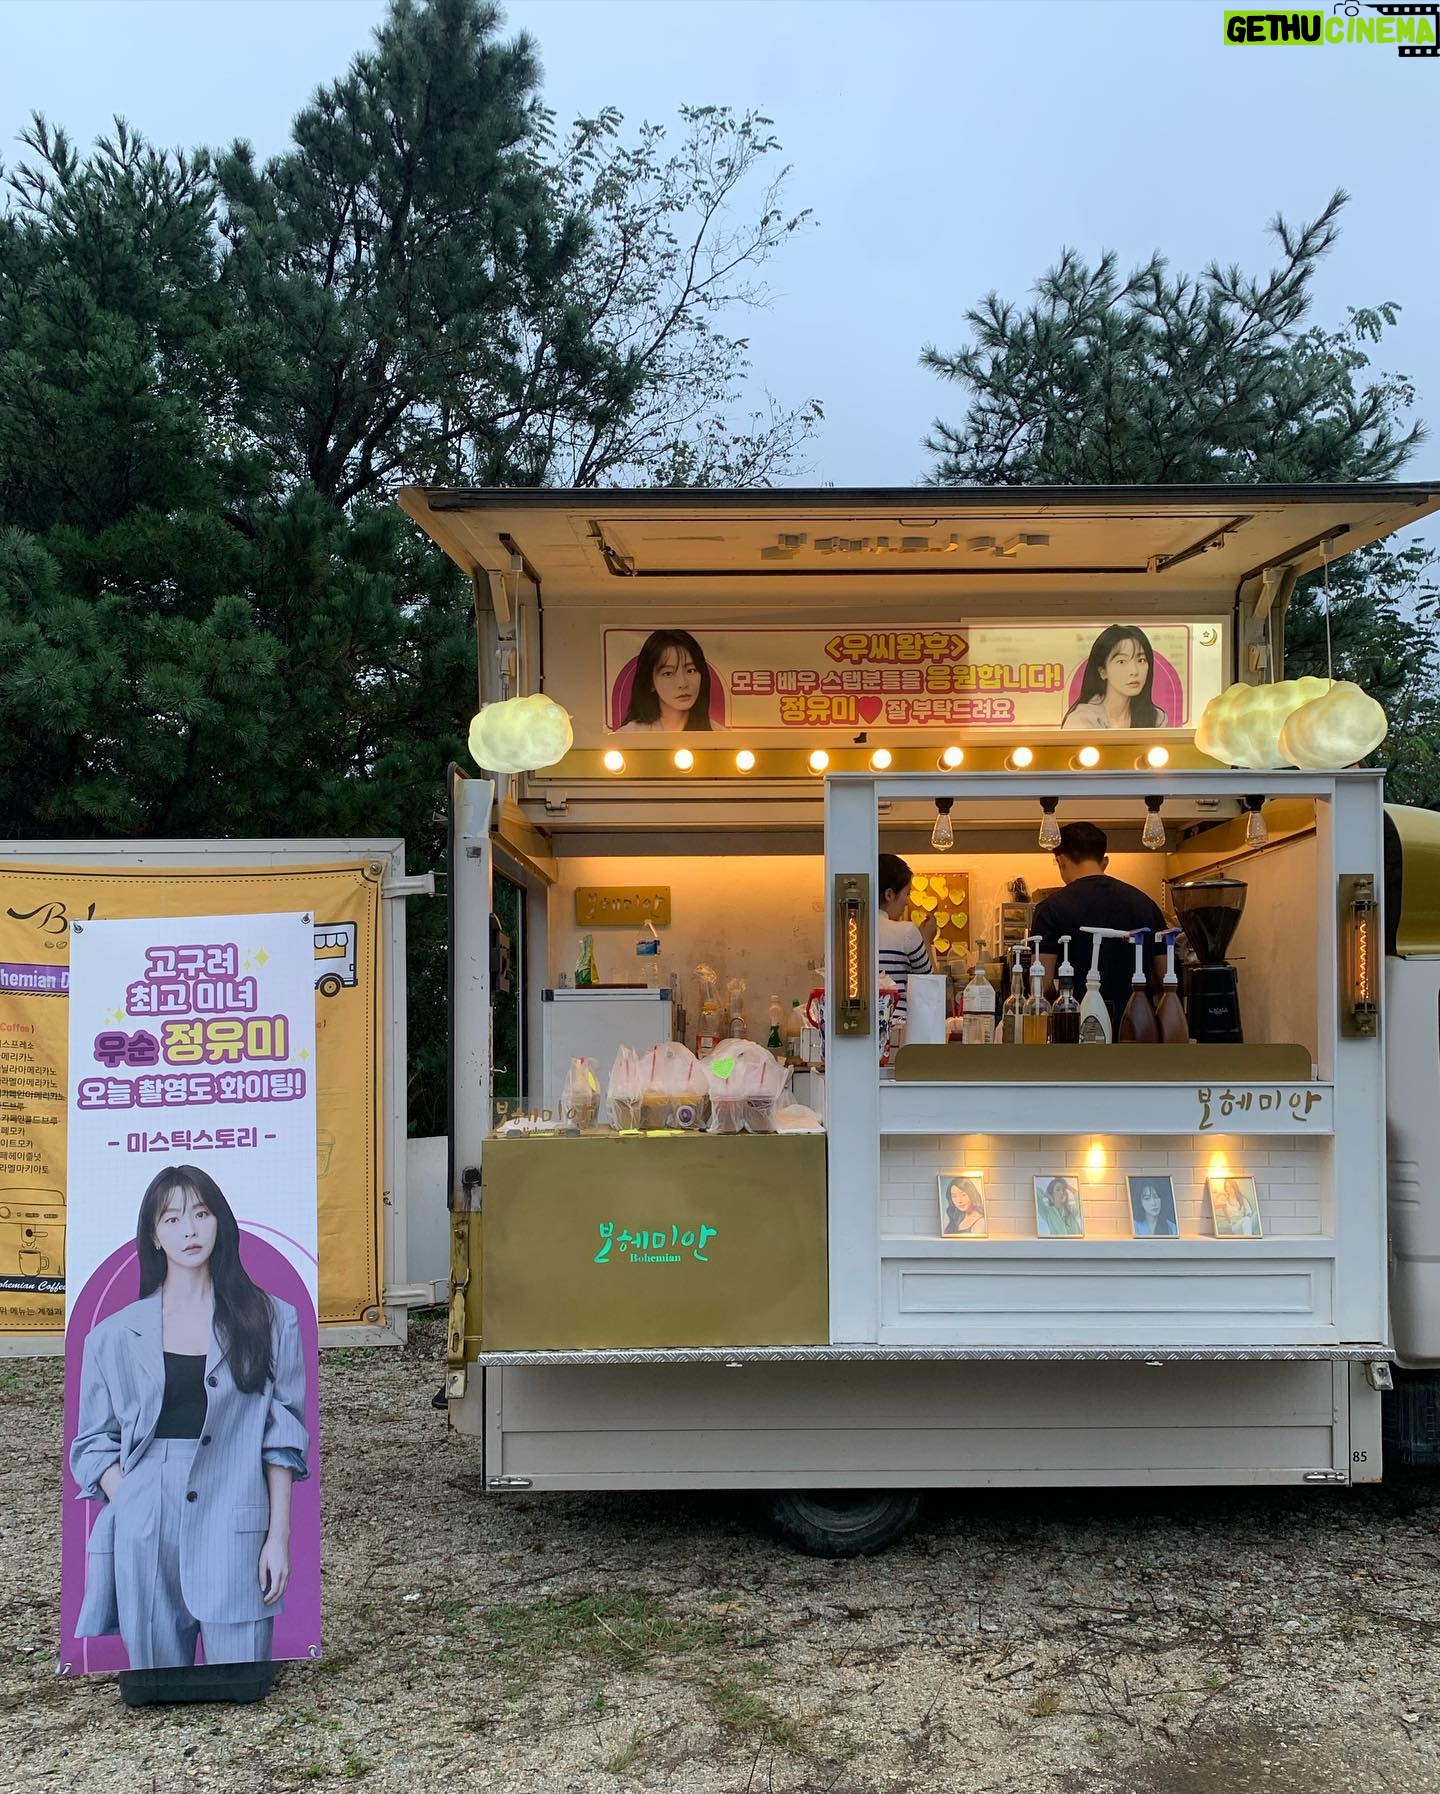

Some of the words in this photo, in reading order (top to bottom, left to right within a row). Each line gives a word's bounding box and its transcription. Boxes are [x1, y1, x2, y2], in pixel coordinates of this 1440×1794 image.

[825, 633, 968, 662] <우씨왕후>
[731, 670, 773, 693] 모든
[776, 670, 819, 693] 배우
[821, 670, 922, 693] 스탭분들을
[926, 664, 1062, 691] 응원합니다!
[781, 697, 858, 723] 정유미
[886, 700, 909, 721] 잘
[911, 698, 1013, 721] 부탁드려요
[147, 945, 236, 978] 고구려
[130, 981, 189, 1013] 최고
[195, 979, 253, 1010] 미녀
[0, 1040, 35, 1050] 스프레소
[97, 1033, 156, 1064] 우순
[164, 1017, 286, 1062] 정유미
[80, 1080, 133, 1106] 오늘
[138, 1077, 214, 1104] 촬영도
[219, 1072, 303, 1100] 화이팅!
[1197, 1087, 1323, 1131] 보헤미안
[126, 1127, 258, 1153] 미스틱스토리
[593, 1221, 718, 1264] 보헤미안
[630, 1253, 682, 1263] Bohemian
[1352, 1450, 1368, 1463] 85
